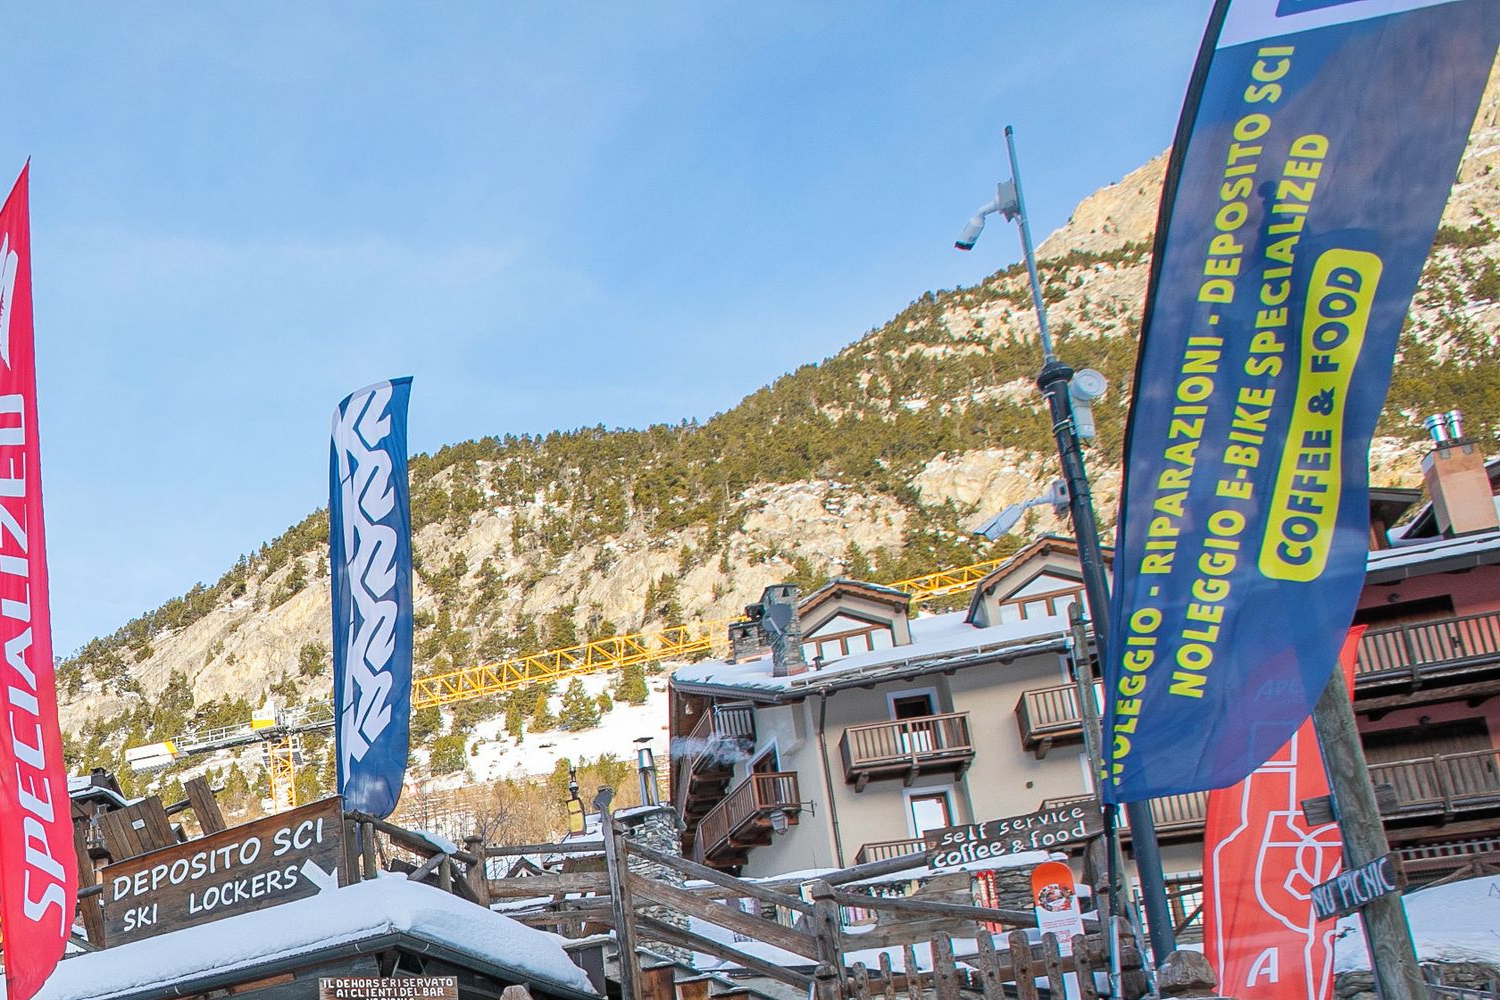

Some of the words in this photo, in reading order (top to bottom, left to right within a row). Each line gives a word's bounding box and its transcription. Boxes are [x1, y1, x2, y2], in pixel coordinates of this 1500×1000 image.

[1244, 133, 1331, 378] SPECIALIZED
[1140, 336, 1225, 575] RIPARAZIONI
[1198, 113, 1271, 304] DEPOSITO
[1244, 45, 1295, 104] SCI
[1309, 266, 1363, 374] FOOD
[1308, 386, 1336, 415] &
[1215, 386, 1277, 499] E-BIKE
[1276, 430, 1333, 566] COFFEE
[1169, 511, 1246, 699] NOLEGGIO
[113, 837, 261, 901] DEPOSITO
[274, 817, 323, 857] SCI
[934, 841, 1006, 868] coffee
[1012, 840, 1027, 854] &
[1031, 820, 1090, 849] food
[941, 822, 987, 846] self
[1000, 806, 1086, 836] service
[123, 903, 158, 932] SKI
[189, 865, 298, 914] LOCKERS
[1338, 857, 1396, 909] PICNIC
[323, 979, 335, 989] IL
[336, 979, 379, 989] DEHORS
[390, 978, 454, 988] RISERVATO
[336, 988, 348, 998] AI
[350, 988, 398, 998] CLIENTI
[400, 987, 421, 997] DEL
[423, 986, 445, 997] BAR
